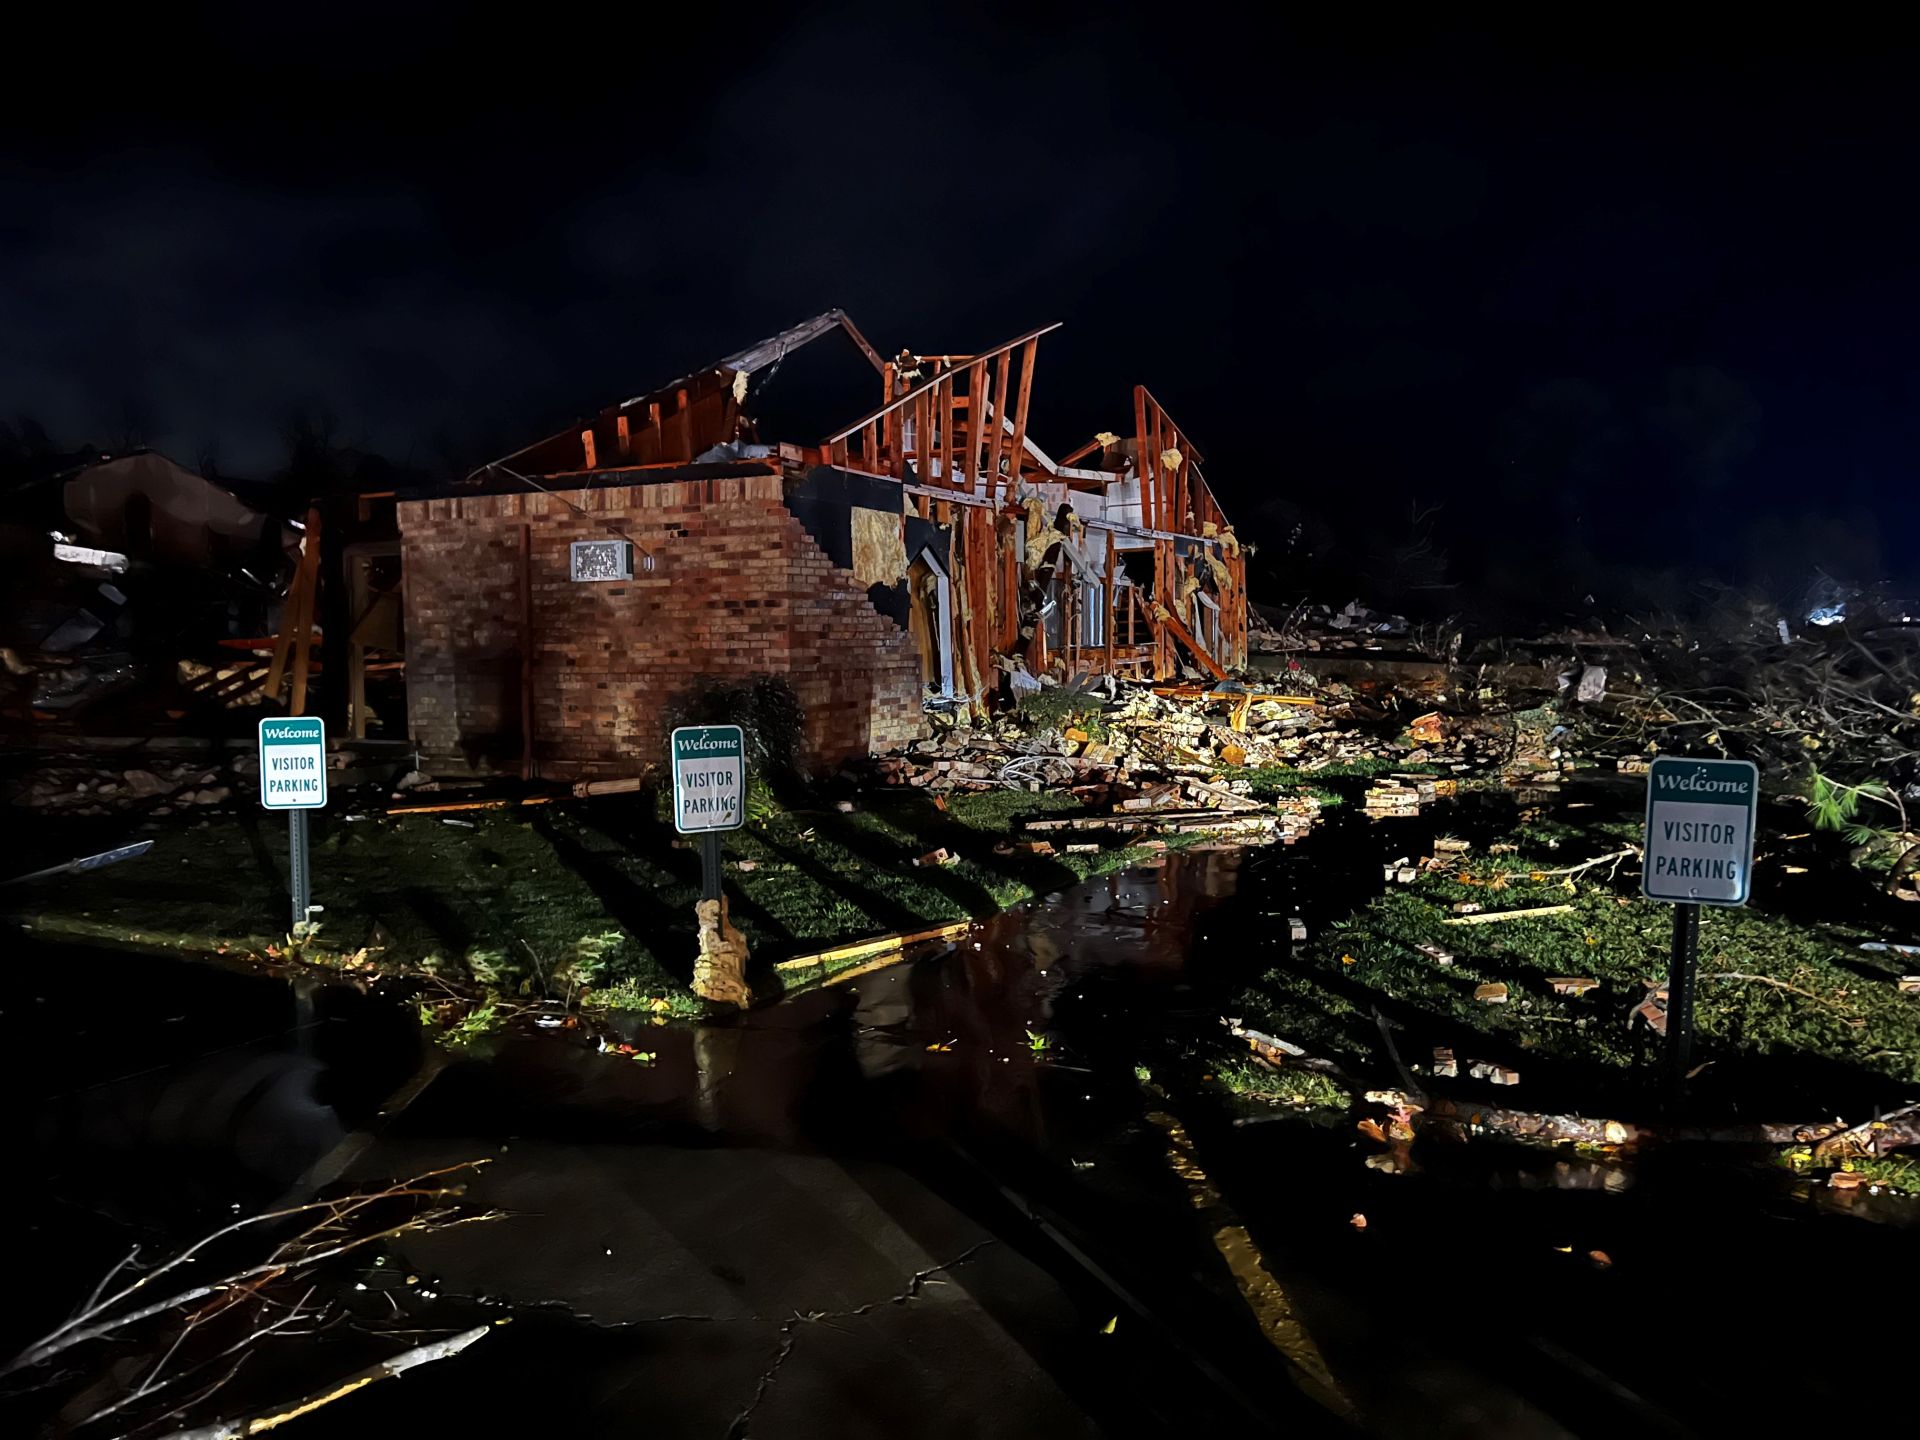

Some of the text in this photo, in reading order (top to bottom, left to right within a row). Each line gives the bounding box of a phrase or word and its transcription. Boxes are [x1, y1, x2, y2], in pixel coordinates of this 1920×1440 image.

[265, 727, 319, 739] Welcome
[678, 738, 739, 751] Welcome
[272, 757, 314, 770] VISITOR
[270, 779, 318, 792] PARKING
[686, 771, 733, 788] VISITOR
[1657, 772, 1749, 794] Welcome
[684, 796, 736, 814] PARKING
[1664, 821, 1735, 844] VISITOR
[1656, 856, 1737, 880] PARKING
